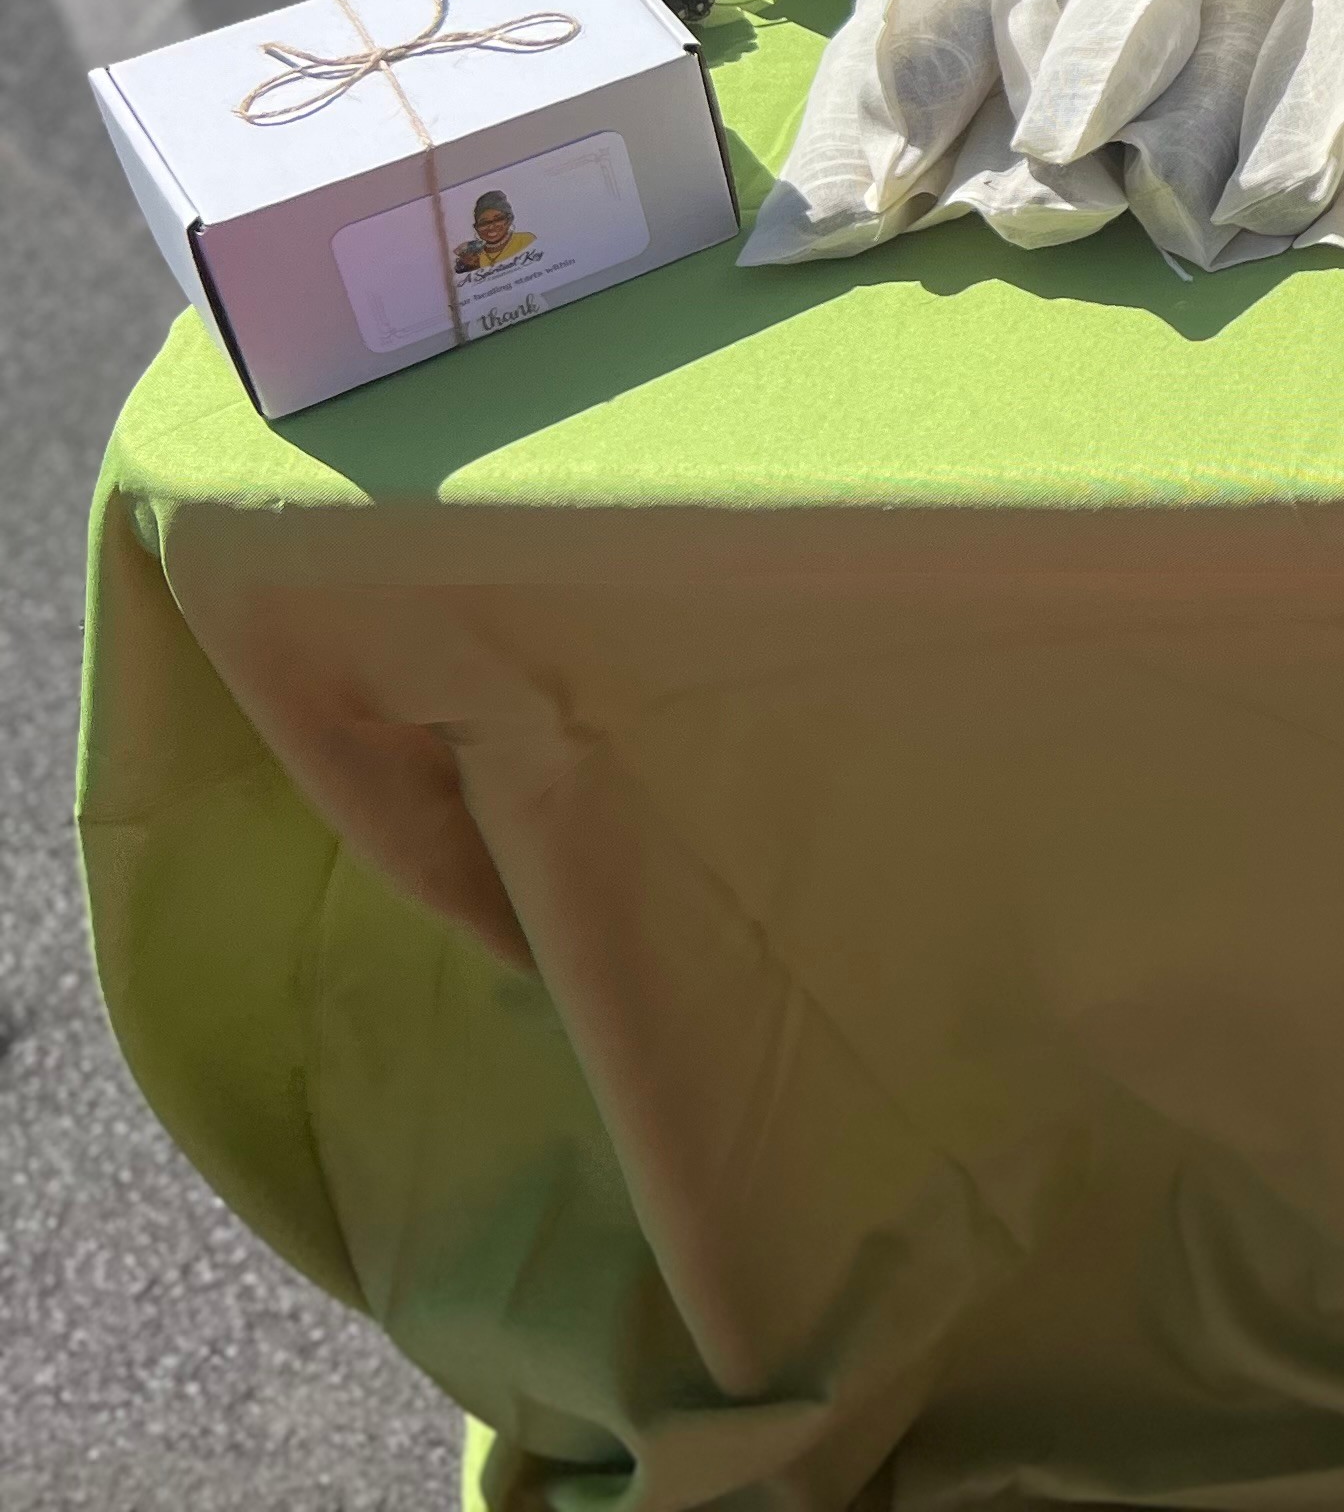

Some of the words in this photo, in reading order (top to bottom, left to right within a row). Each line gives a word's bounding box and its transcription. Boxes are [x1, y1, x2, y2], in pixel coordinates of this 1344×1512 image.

[456, 272, 472, 288] A
[473, 256, 520, 283] Spiritual
[518, 248, 545, 267] Key
[473, 283, 513, 301] healing
[514, 271, 544, 284] starts
[546, 258, 577, 273] within
[481, 293, 540, 331] thank
